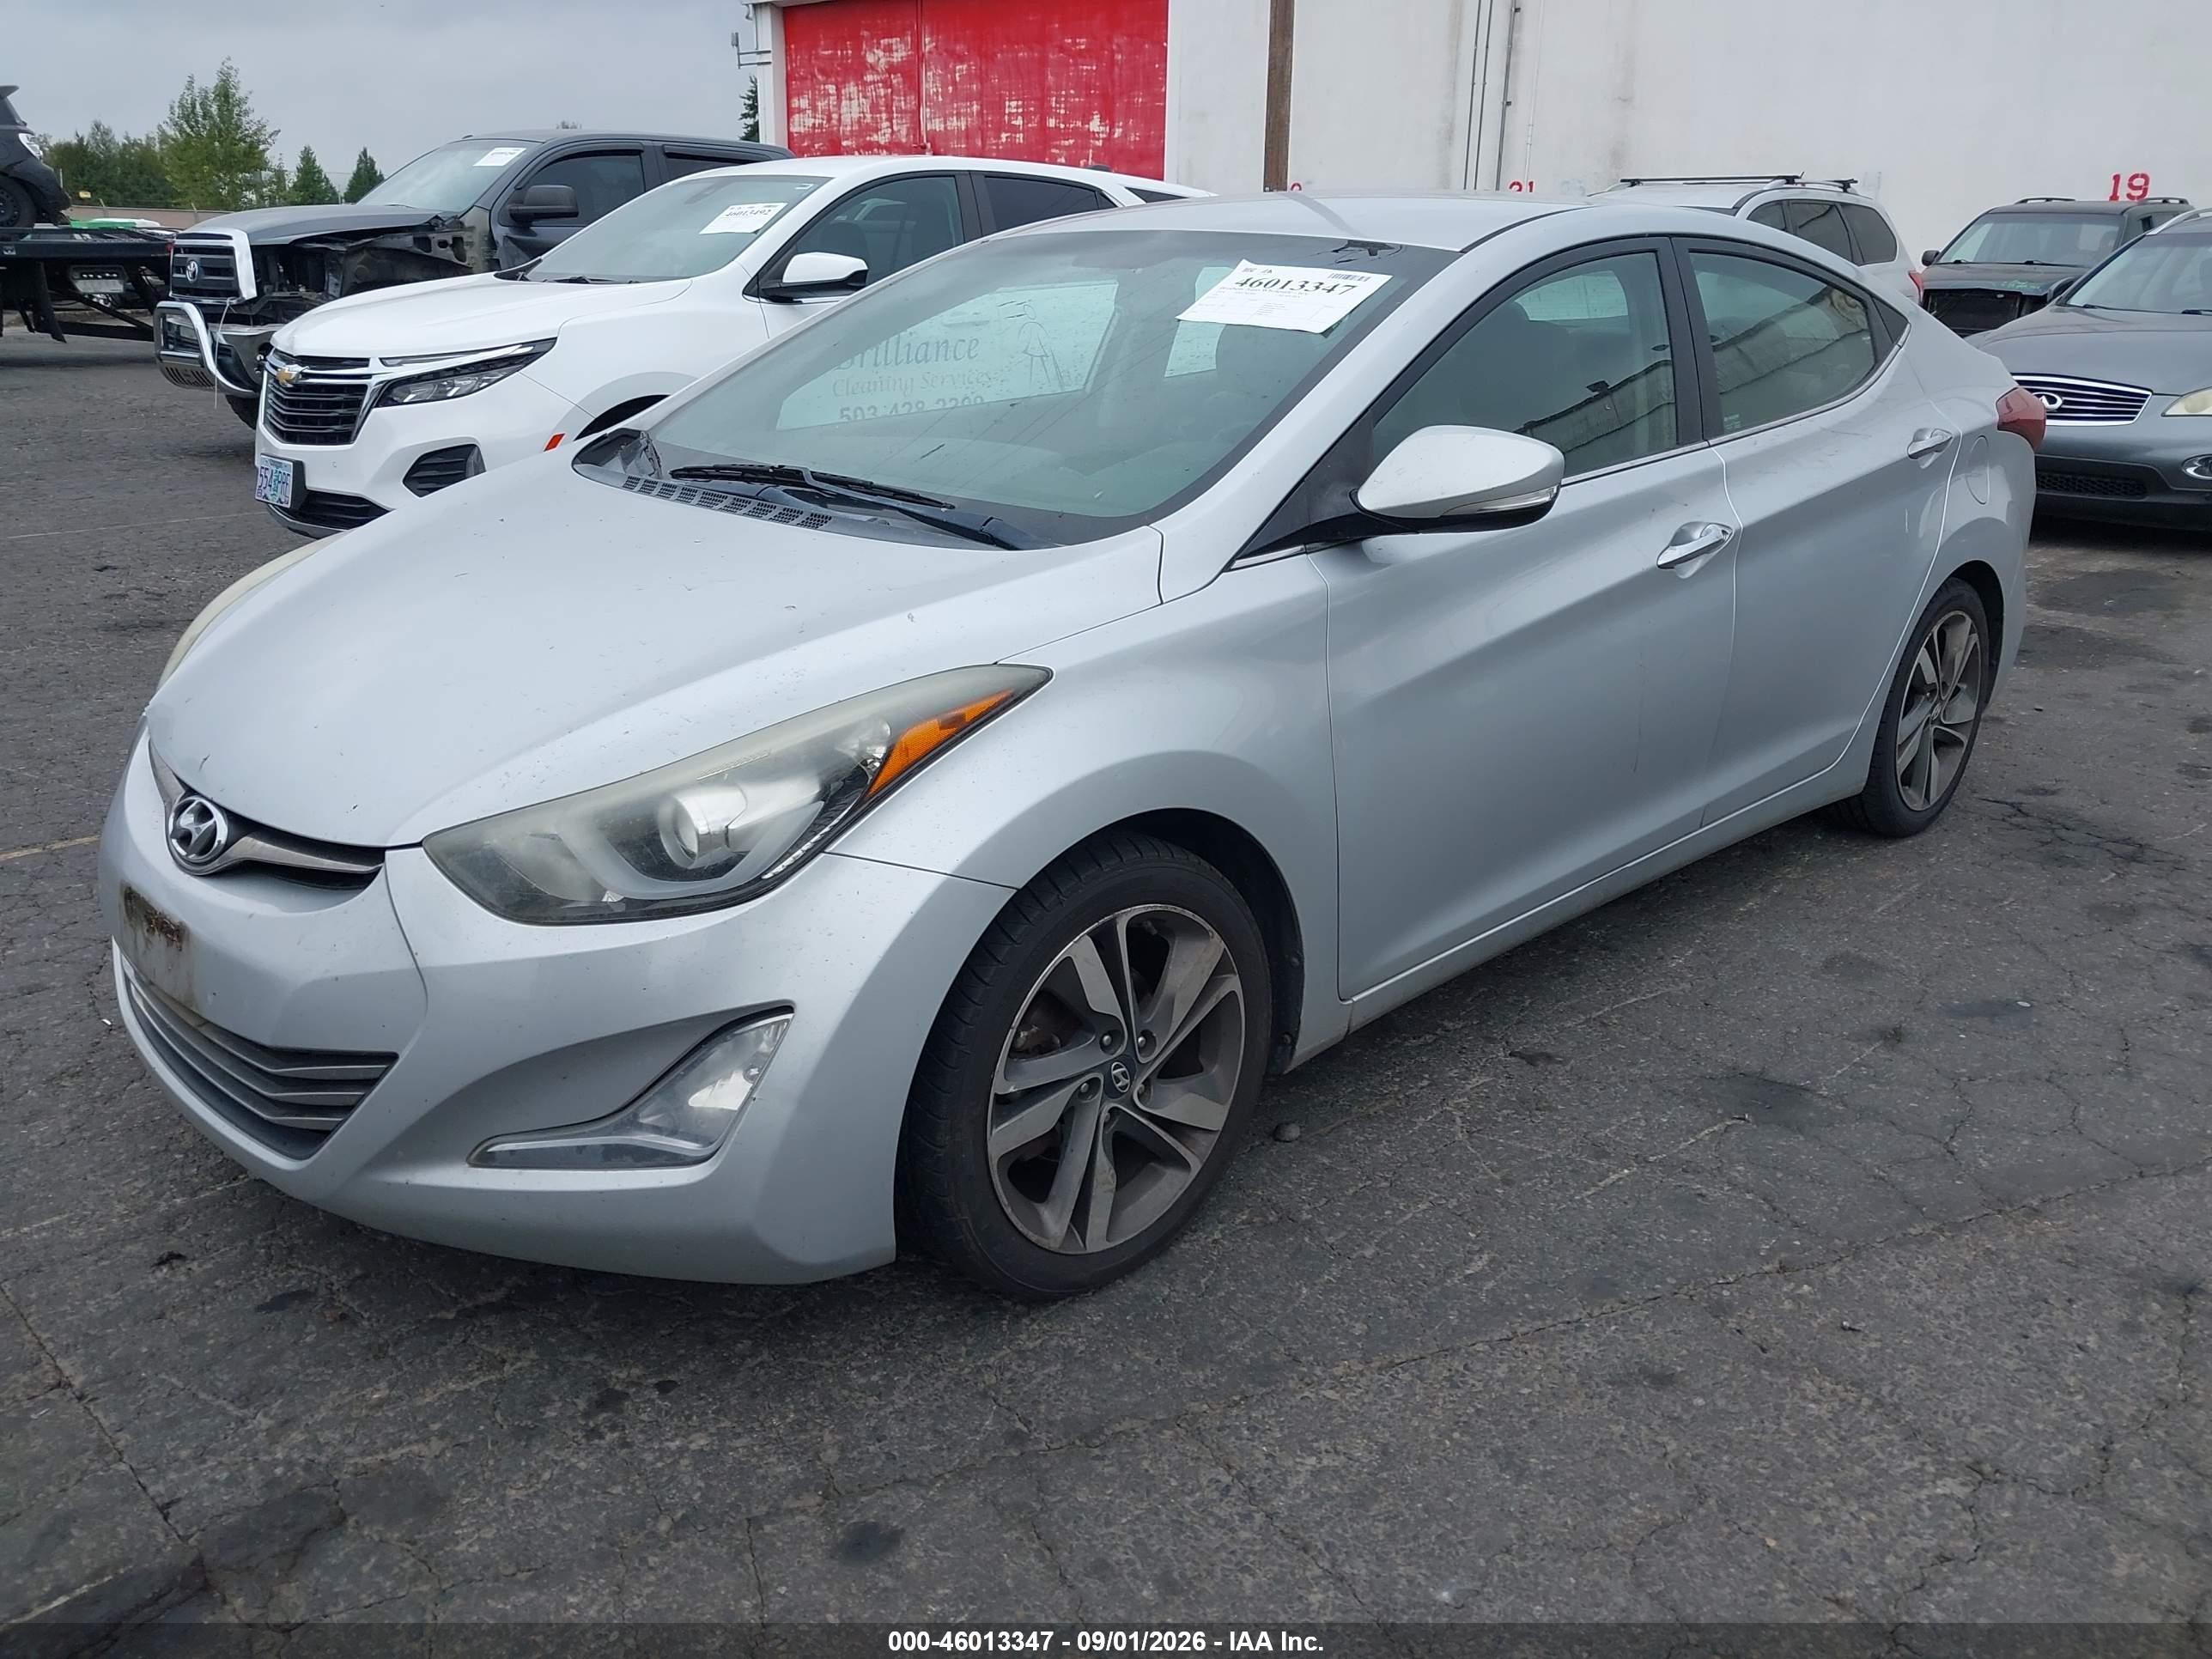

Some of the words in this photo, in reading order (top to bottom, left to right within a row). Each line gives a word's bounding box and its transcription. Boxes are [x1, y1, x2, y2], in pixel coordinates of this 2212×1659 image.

[2109, 173, 2150, 202] 19
[1234, 276, 1358, 296] 46013347
[833, 332, 980, 370] rilliance
[832, 375, 915, 398] Cleaning
[920, 370, 991, 391] Services
